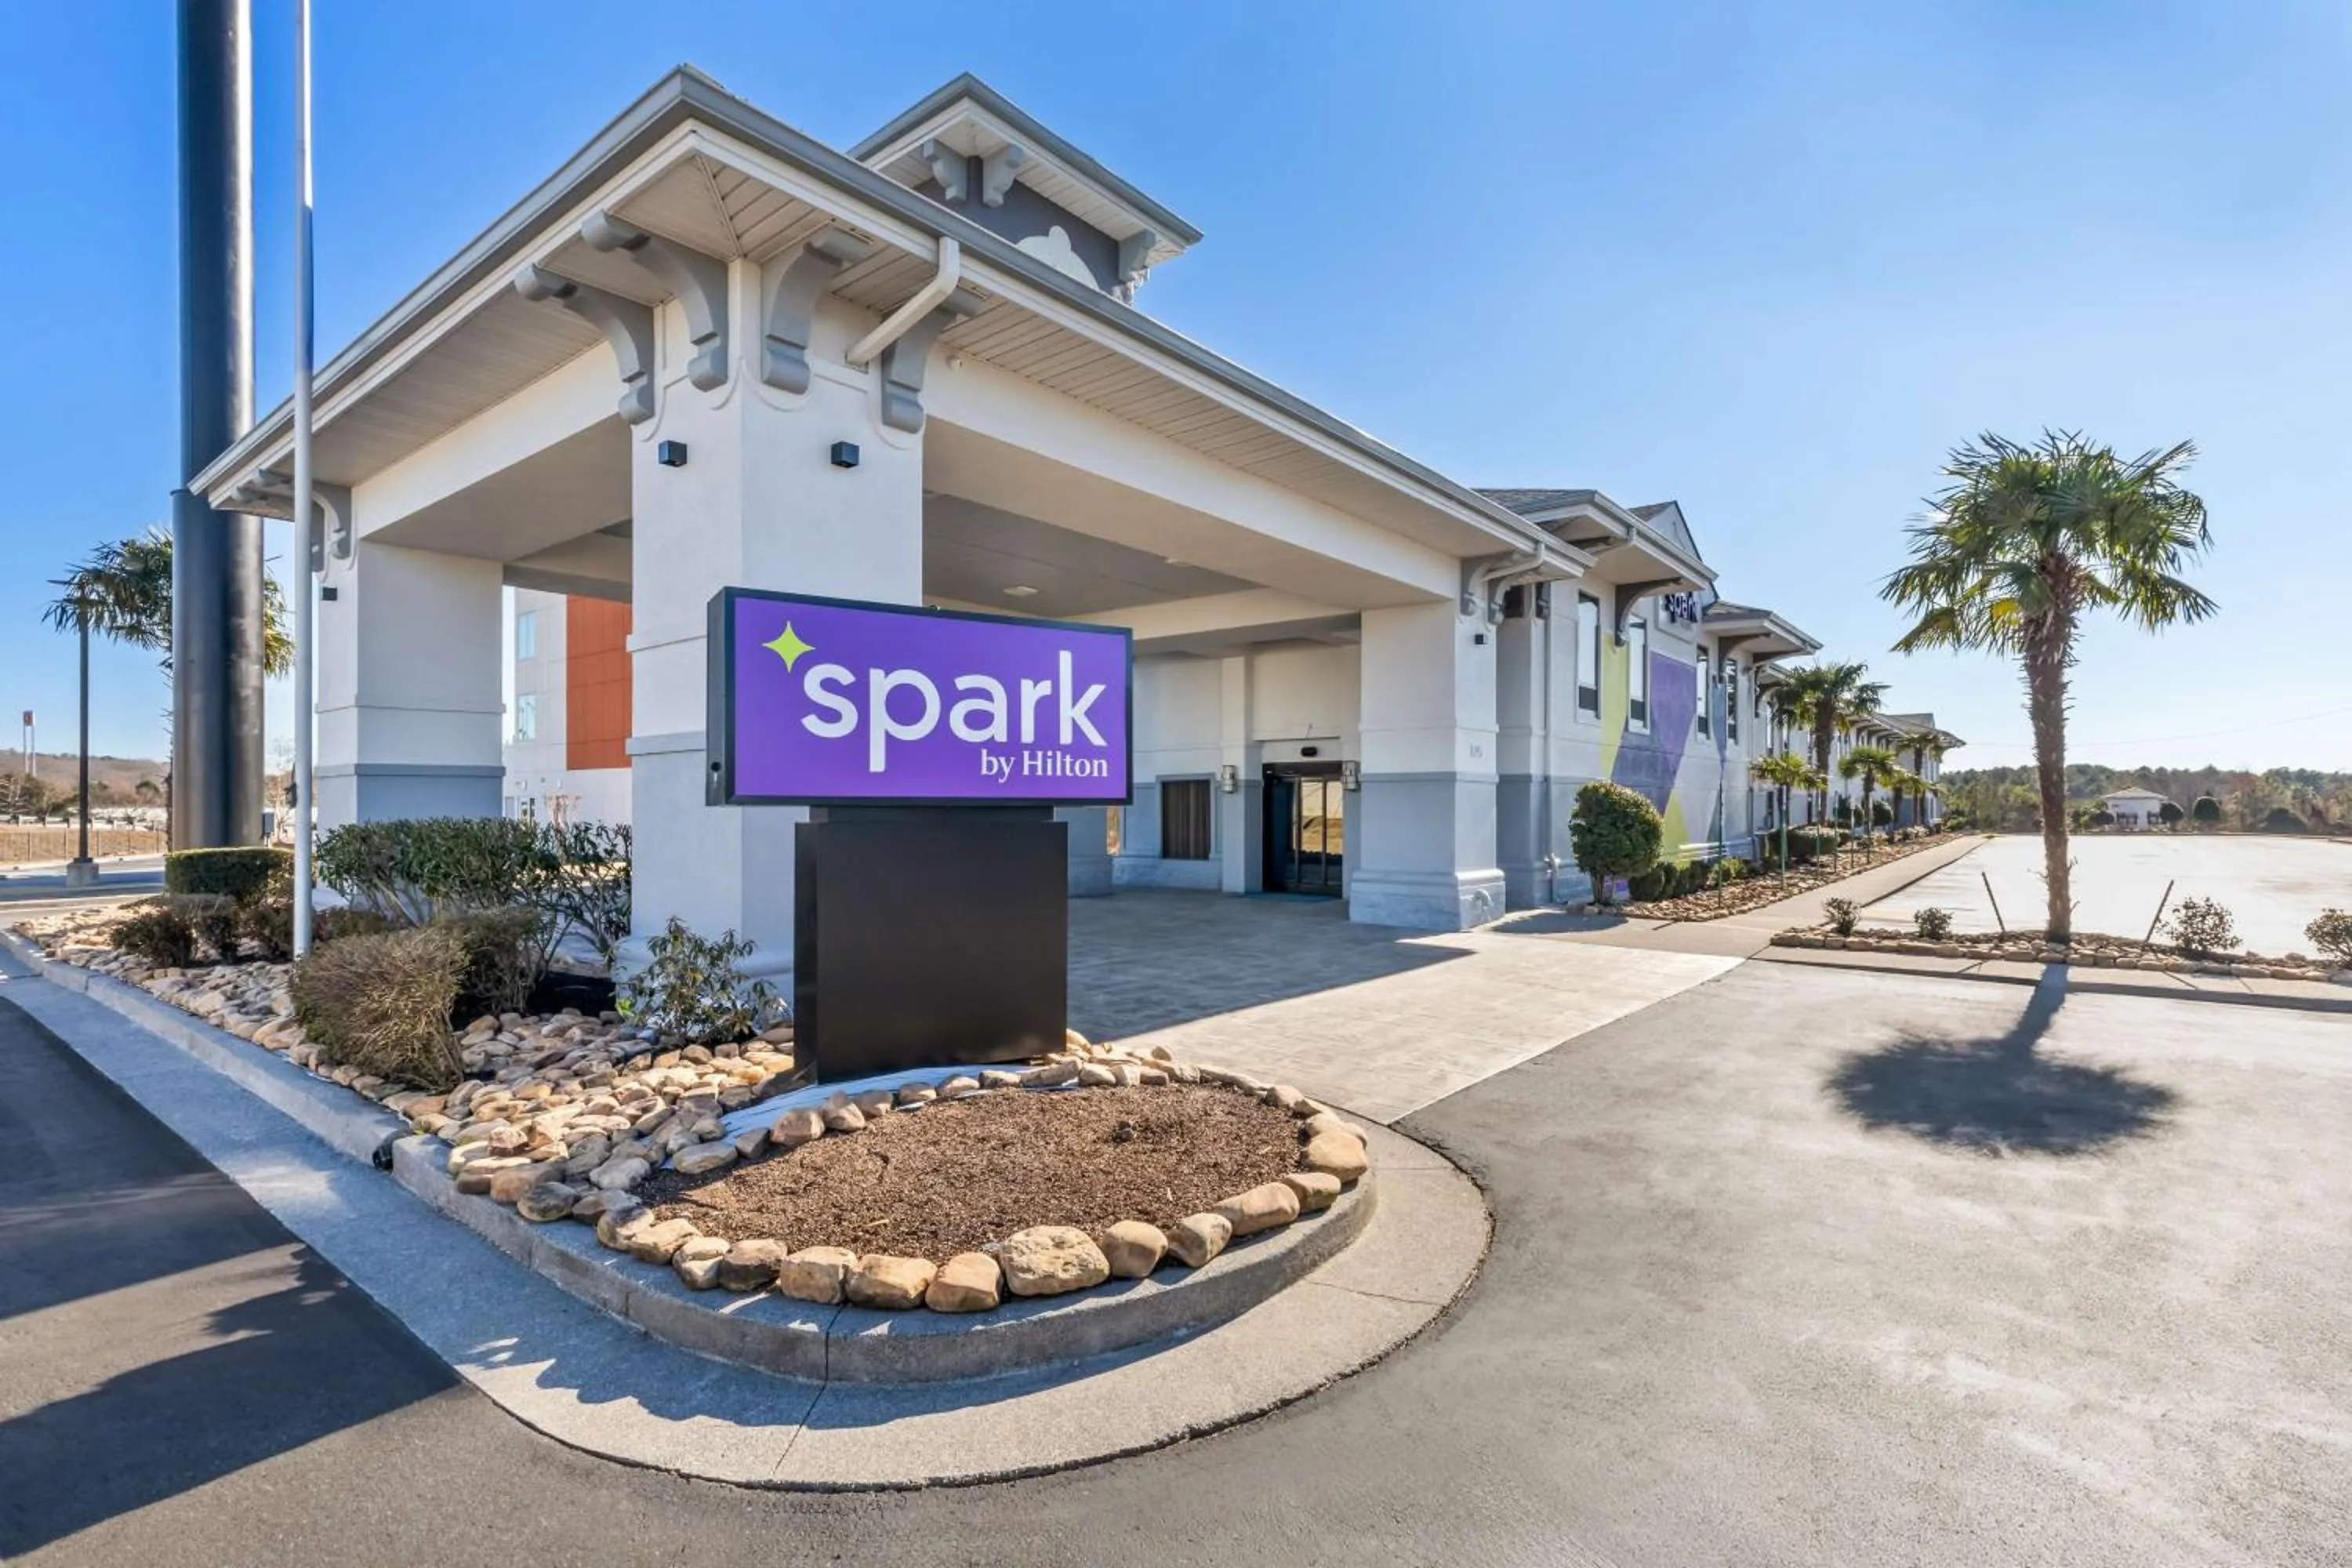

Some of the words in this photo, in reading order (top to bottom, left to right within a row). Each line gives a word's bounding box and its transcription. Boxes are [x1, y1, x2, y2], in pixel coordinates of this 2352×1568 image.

[800, 650, 1108, 772] spark
[981, 749, 1015, 782] by
[1022, 750, 1108, 777] Hilton
